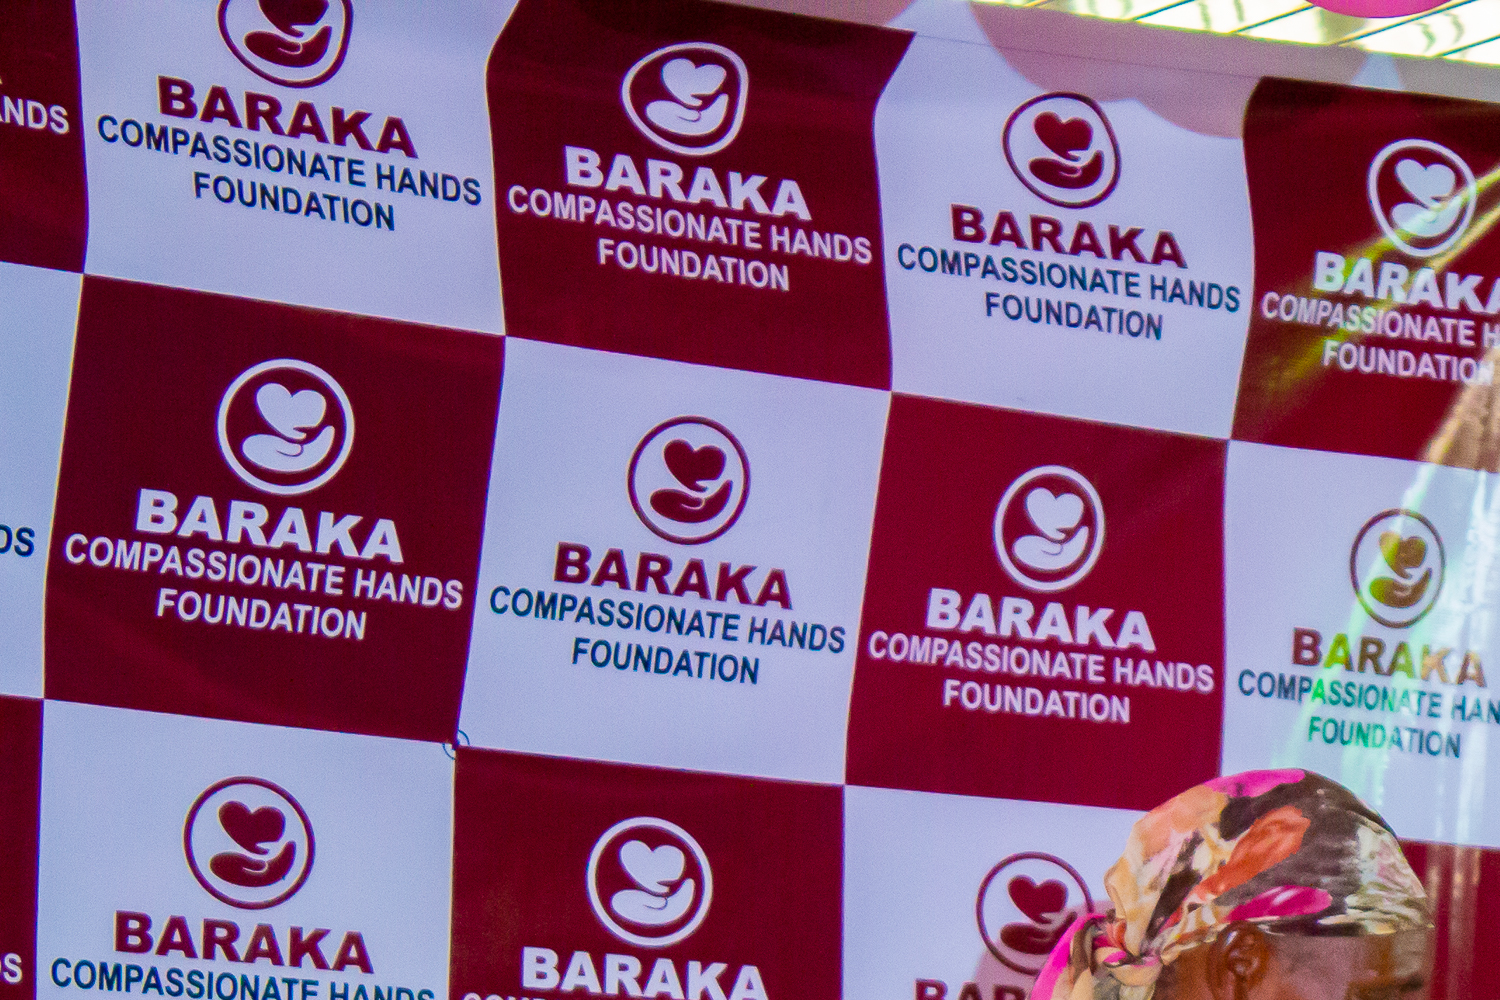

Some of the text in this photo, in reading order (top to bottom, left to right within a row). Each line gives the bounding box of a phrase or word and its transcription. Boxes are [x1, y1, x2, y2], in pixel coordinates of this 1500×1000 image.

[0, 94, 70, 135] NDS
[159, 76, 418, 159] BARAKA
[98, 115, 481, 206] COMPASSIONATE HANDS
[566, 146, 812, 221] BARAKA
[195, 172, 394, 231] FOUNDATION
[509, 186, 872, 264] COMPASSIONATE HANDS
[599, 239, 789, 291] FOUNDATION
[952, 204, 1188, 269] BARAKA
[898, 243, 1240, 312] COMPASSIONATE HANDS
[986, 292, 1162, 340] FOUNDATION
[1262, 291, 1475, 347] COMPASSIONATE
[1322, 339, 1494, 385] FOUNDATION
[137, 489, 403, 563] BARAKA
[66, 534, 345, 595] COMPASSIONATE
[355, 569, 463, 608] HANDS
[554, 543, 792, 610] BARAKA
[158, 588, 366, 640] FOUNDATION
[490, 586, 845, 653] COMPASSIONATE HANDS
[927, 588, 1156, 652] BARAKA
[572, 638, 759, 684] FOUNDATION
[870, 631, 1214, 692] COMPASSIONATE HANDS
[1291, 627, 1487, 688] BARAKA
[945, 679, 1130, 723] FOUNDATION
[1238, 669, 1441, 718] COMPASSIONATE
[1309, 716, 1461, 758] FOUNDATION
[116, 911, 374, 974] BARAKA
